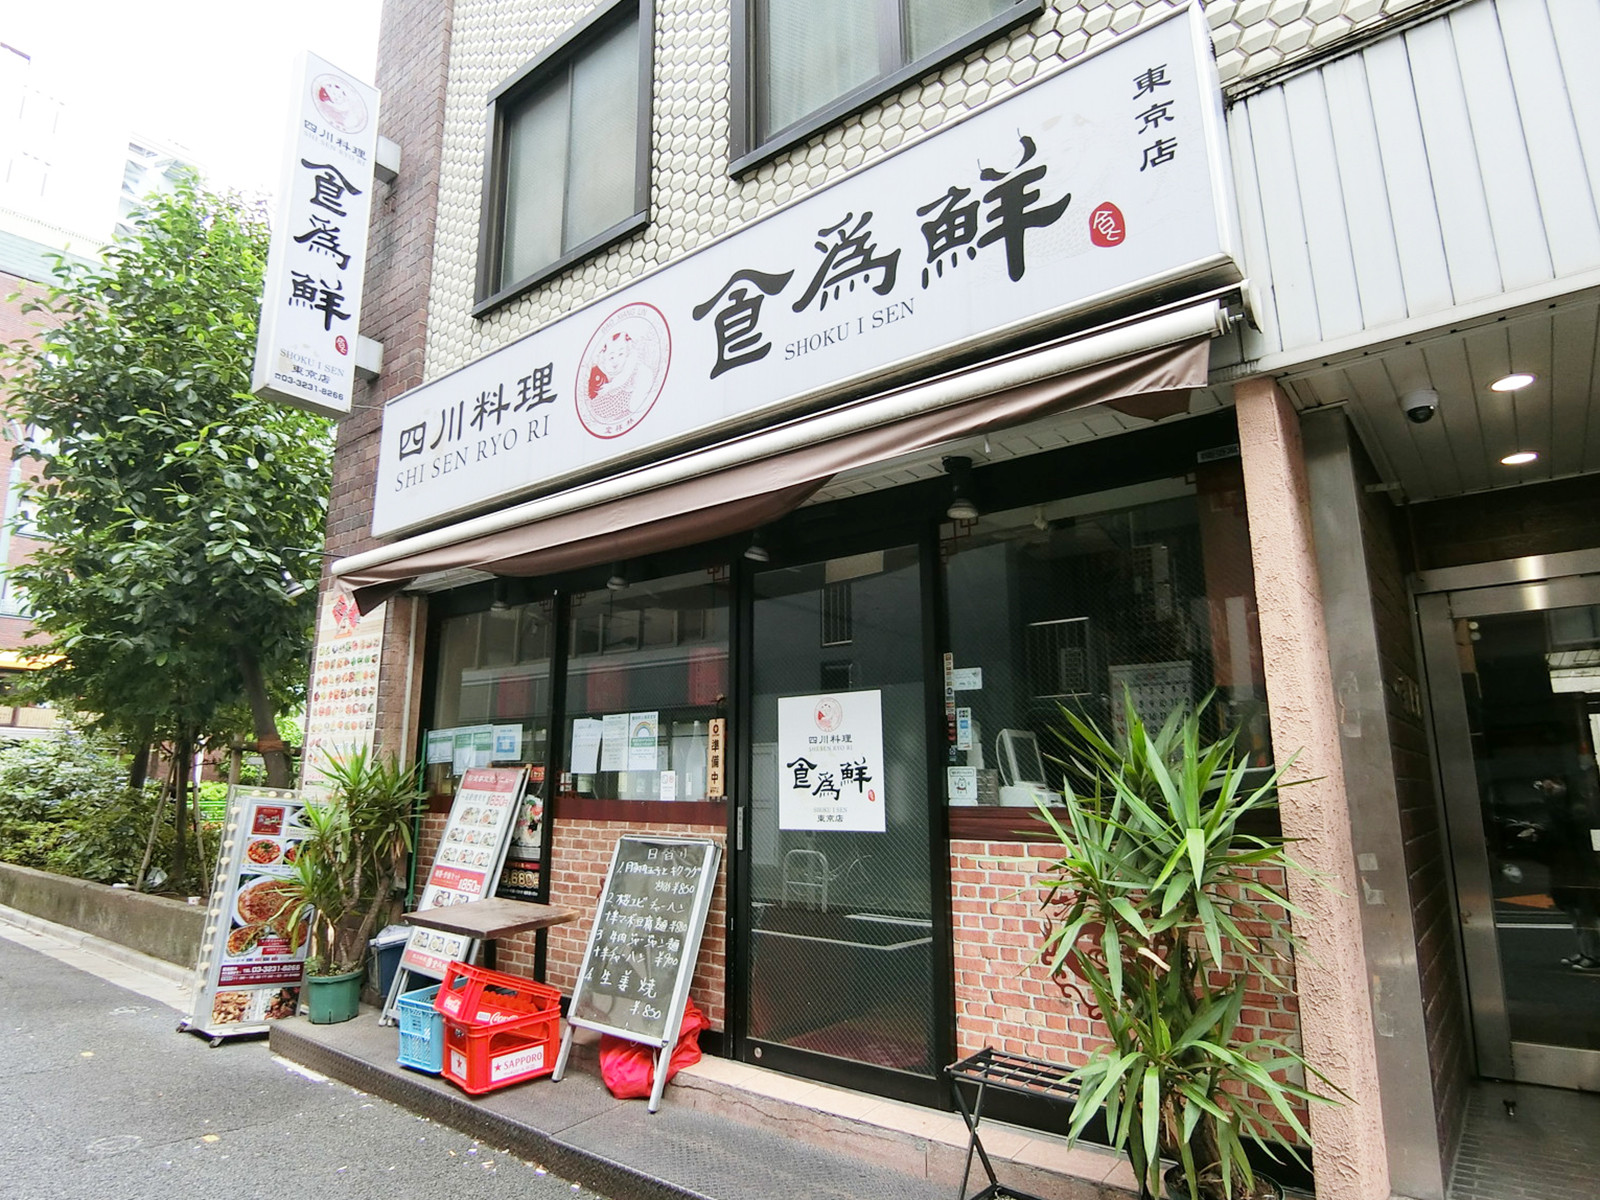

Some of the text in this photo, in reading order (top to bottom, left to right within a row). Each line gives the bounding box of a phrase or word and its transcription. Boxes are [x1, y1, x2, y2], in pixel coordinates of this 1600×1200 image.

[1132, 64, 1178, 172] 東京店
[304, 119, 366, 160] 四川料理
[784, 297, 915, 362] SHOKU I SEN
[280, 348, 314, 366] SHOKU
[324, 365, 345, 377] SEN
[292, 365, 330, 384] 東京店
[281, 374, 344, 400] 03-3231-8266
[399, 362, 558, 461] 四川料理
[395, 414, 549, 492] SHI SEN RYO RI
[808, 734, 853, 744] 四川料理
[655, 951, 678, 967] ¥900
[504, 1052, 542, 1070] SAPPORO
